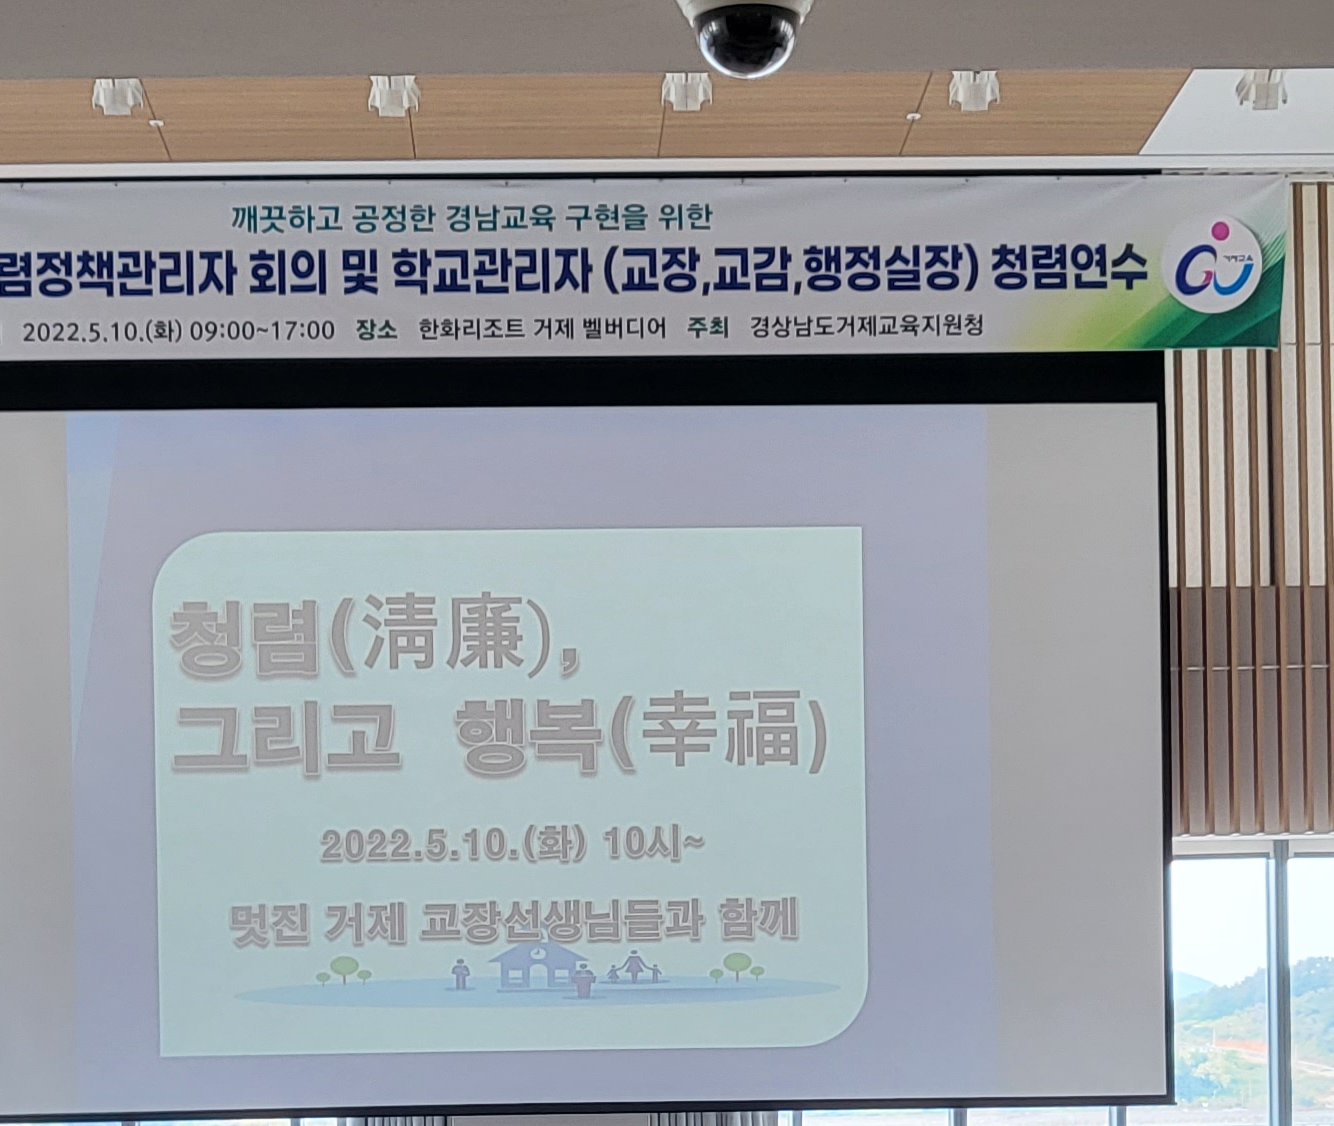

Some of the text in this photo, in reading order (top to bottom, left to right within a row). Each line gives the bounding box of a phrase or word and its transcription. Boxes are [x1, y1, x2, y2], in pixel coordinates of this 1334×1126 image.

[231, 203, 714, 234] 깨끗하고 공정한 경남교육 구현을 위한
[249, 248, 327, 296] 회의
[342, 248, 379, 296] 및
[391, 247, 594, 296] 학교관리자
[603, 242, 979, 297] (교장,교감,행정실장)
[991, 242, 1148, 291] 청렴연수
[23, 319, 182, 344] 2022.5.10.(화)
[190, 320, 335, 343] 09:00~17:00
[356, 318, 398, 341] 장소
[419, 317, 526, 341] 한화리조트
[533, 317, 574, 340] 거제
[582, 316, 666, 340] 벨버디어
[687, 315, 729, 339] 주최
[750, 313, 983, 339] 경상남도거제교육지원청
[171, 689, 828, 777] 그리고 행복(幸福)
[319, 823, 706, 863] 2022.5.10.(화) 10시~
[229, 896, 800, 947] 멋진 거제 교장선생님들과 함께
